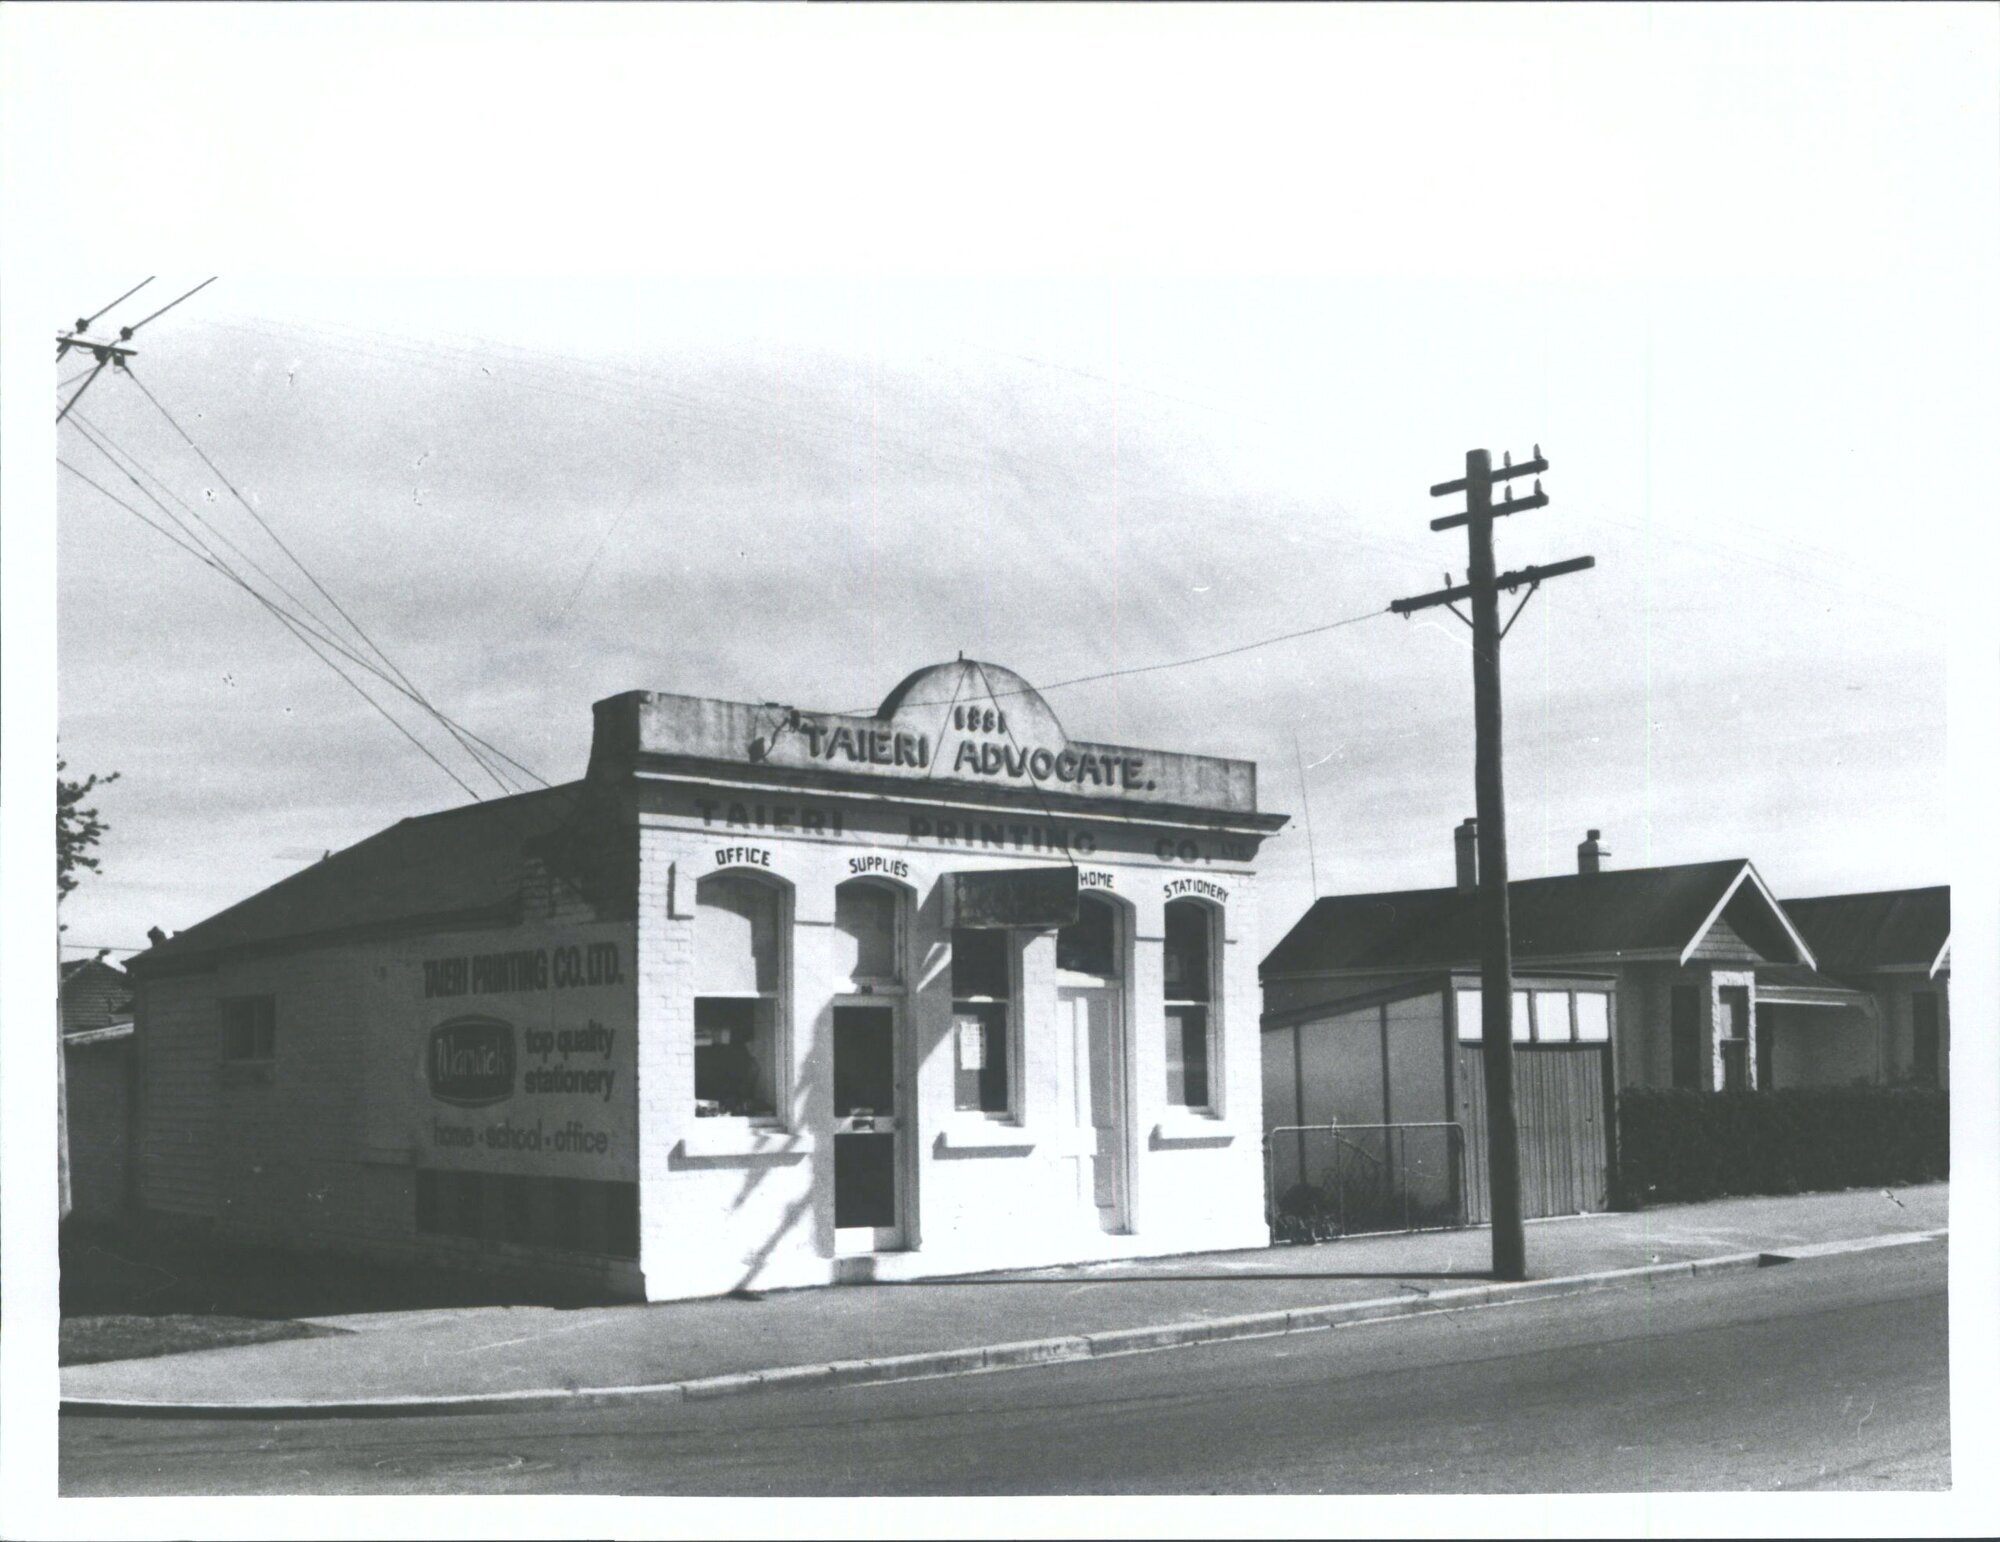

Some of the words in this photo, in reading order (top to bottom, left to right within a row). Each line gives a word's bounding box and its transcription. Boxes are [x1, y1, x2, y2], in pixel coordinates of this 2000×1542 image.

[803, 723, 929, 767] TAIERI
[954, 740, 1155, 790] ADVOCATE.
[697, 800, 843, 836] TAIERI
[910, 817, 1096, 854] PRINTING
[715, 847, 770, 867] OFFICE
[849, 856, 909, 878] SUPPLIES
[1079, 871, 1114, 889] HOME
[1163, 879, 1229, 902] STATIONERY
[423, 957, 468, 998] TAIERI
[472, 948, 548, 995] PRINTING
[586, 942, 625, 986] LTD.
[436, 1034, 506, 1082] Warwick
[525, 1028, 553, 1063] top
[557, 1018, 616, 1060] quality
[524, 1065, 616, 1103] stationery
